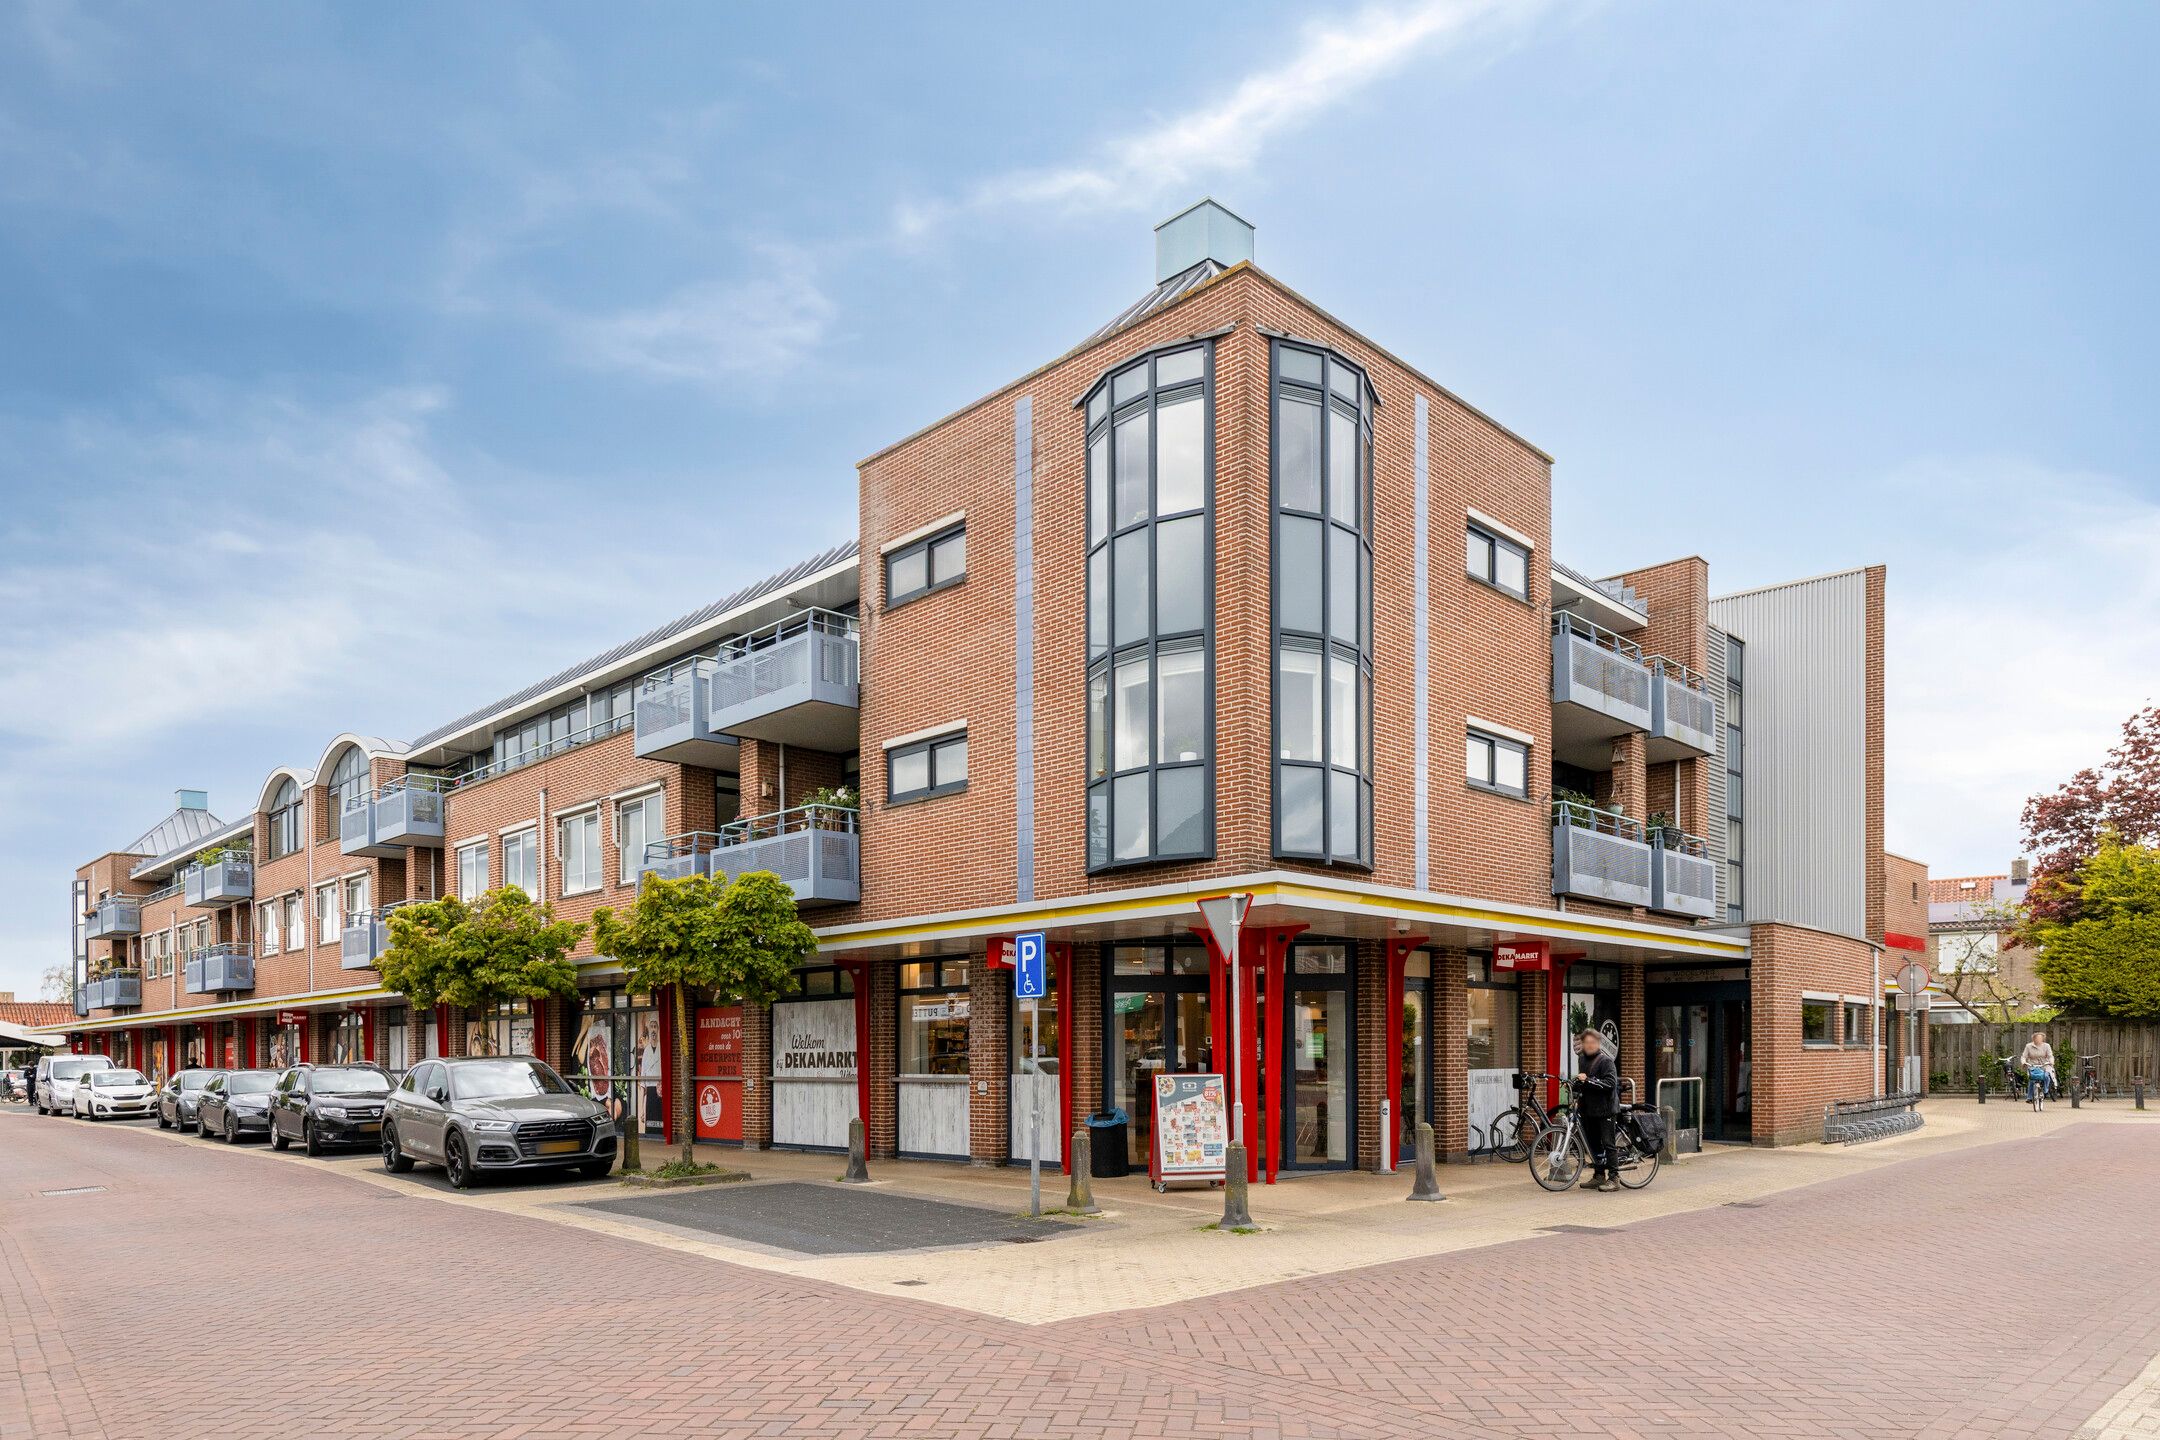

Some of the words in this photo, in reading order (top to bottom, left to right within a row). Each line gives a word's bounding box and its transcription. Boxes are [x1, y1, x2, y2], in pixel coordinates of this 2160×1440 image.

[1022, 941, 1037, 972] P
[1498, 952, 1539, 960] DEKAMARKT
[700, 1017, 741, 1028] AANDACHT
[791, 1034, 824, 1049] Welkom
[785, 1051, 857, 1068] DEKAMARKT
